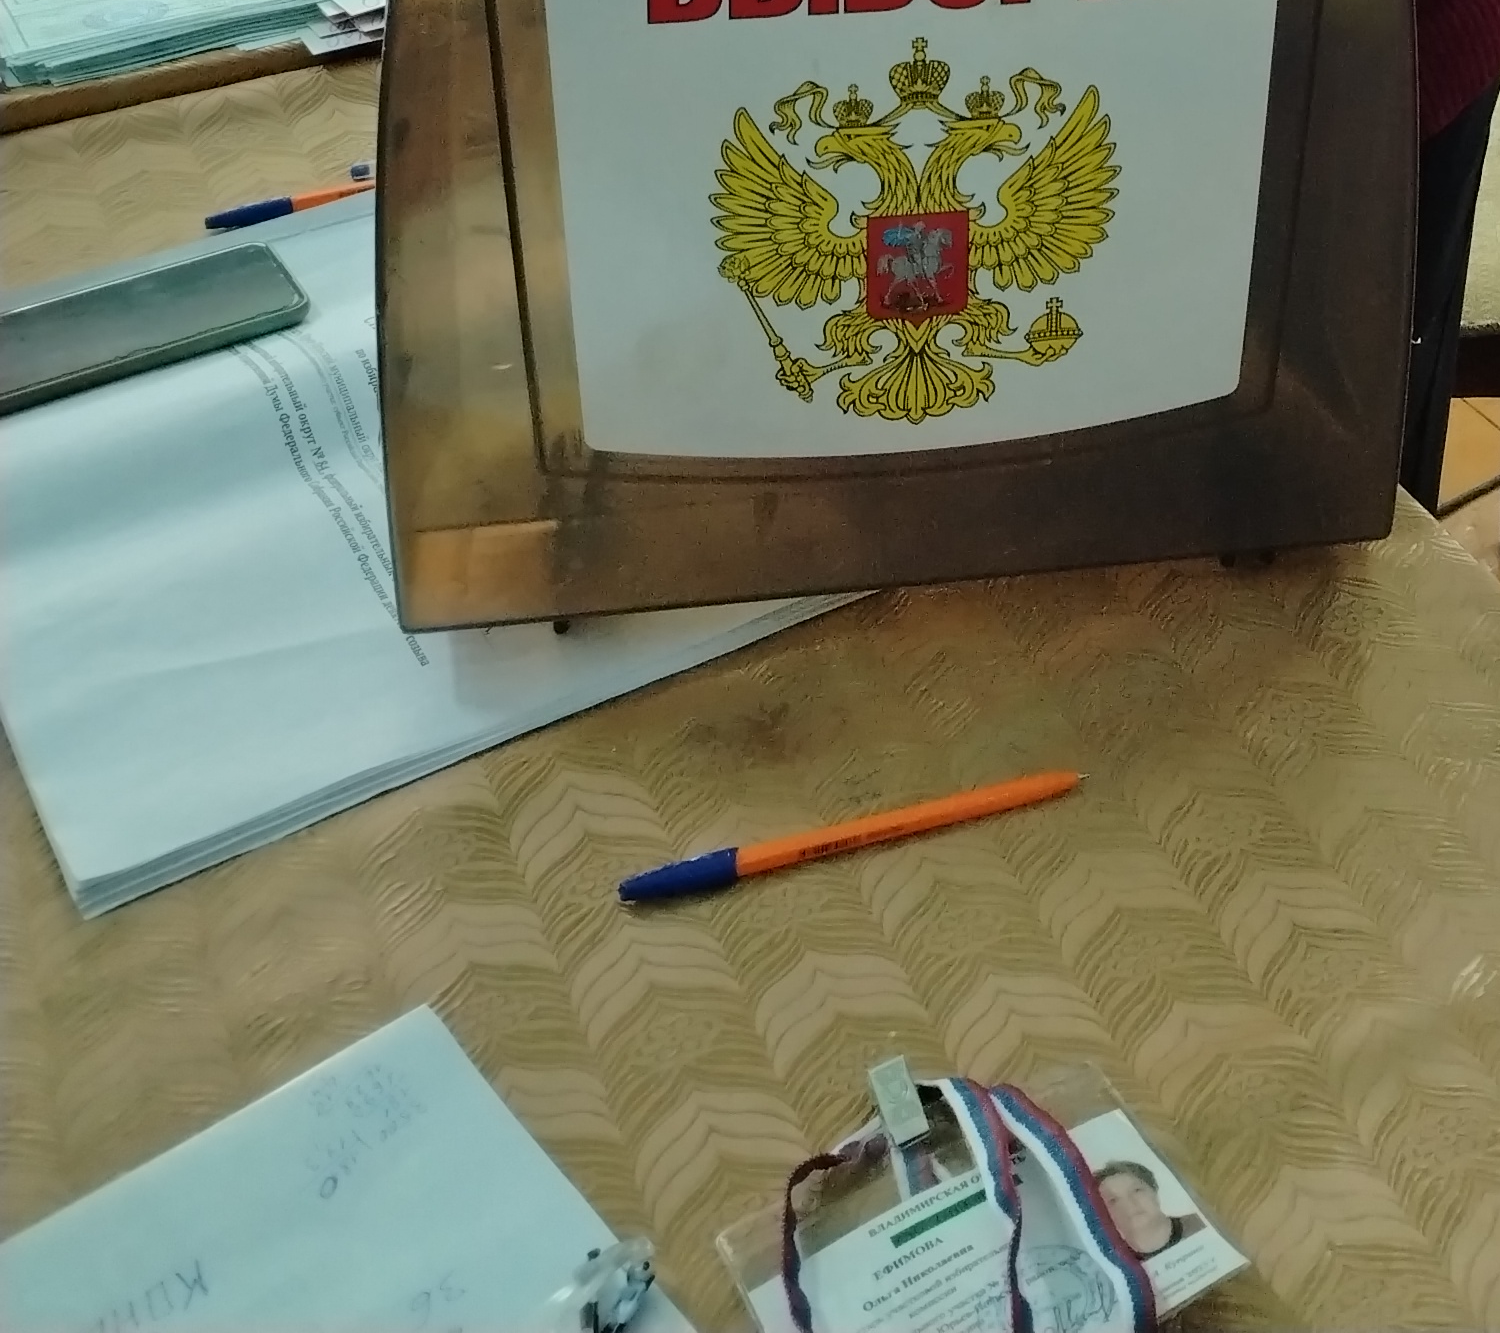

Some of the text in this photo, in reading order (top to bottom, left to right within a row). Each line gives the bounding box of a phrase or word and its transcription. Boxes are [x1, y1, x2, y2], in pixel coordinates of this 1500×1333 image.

[298, 412, 317, 445] округ
[310, 445, 325, 460] №
[329, 364, 370, 445] муниципальный
[264, 383, 284, 413] Думы
[279, 412, 313, 483] Федерального
[329, 506, 364, 554] Российской
[357, 551, 389, 601] Федерации
[405, 634, 430, 668] созыва
[867, 1179, 970, 1238] ВЛАДИМИРСКАЯ
[863, 1244, 975, 1312] Ольга Николаевна
[873, 1237, 944, 1281] ЕФИМОВА
